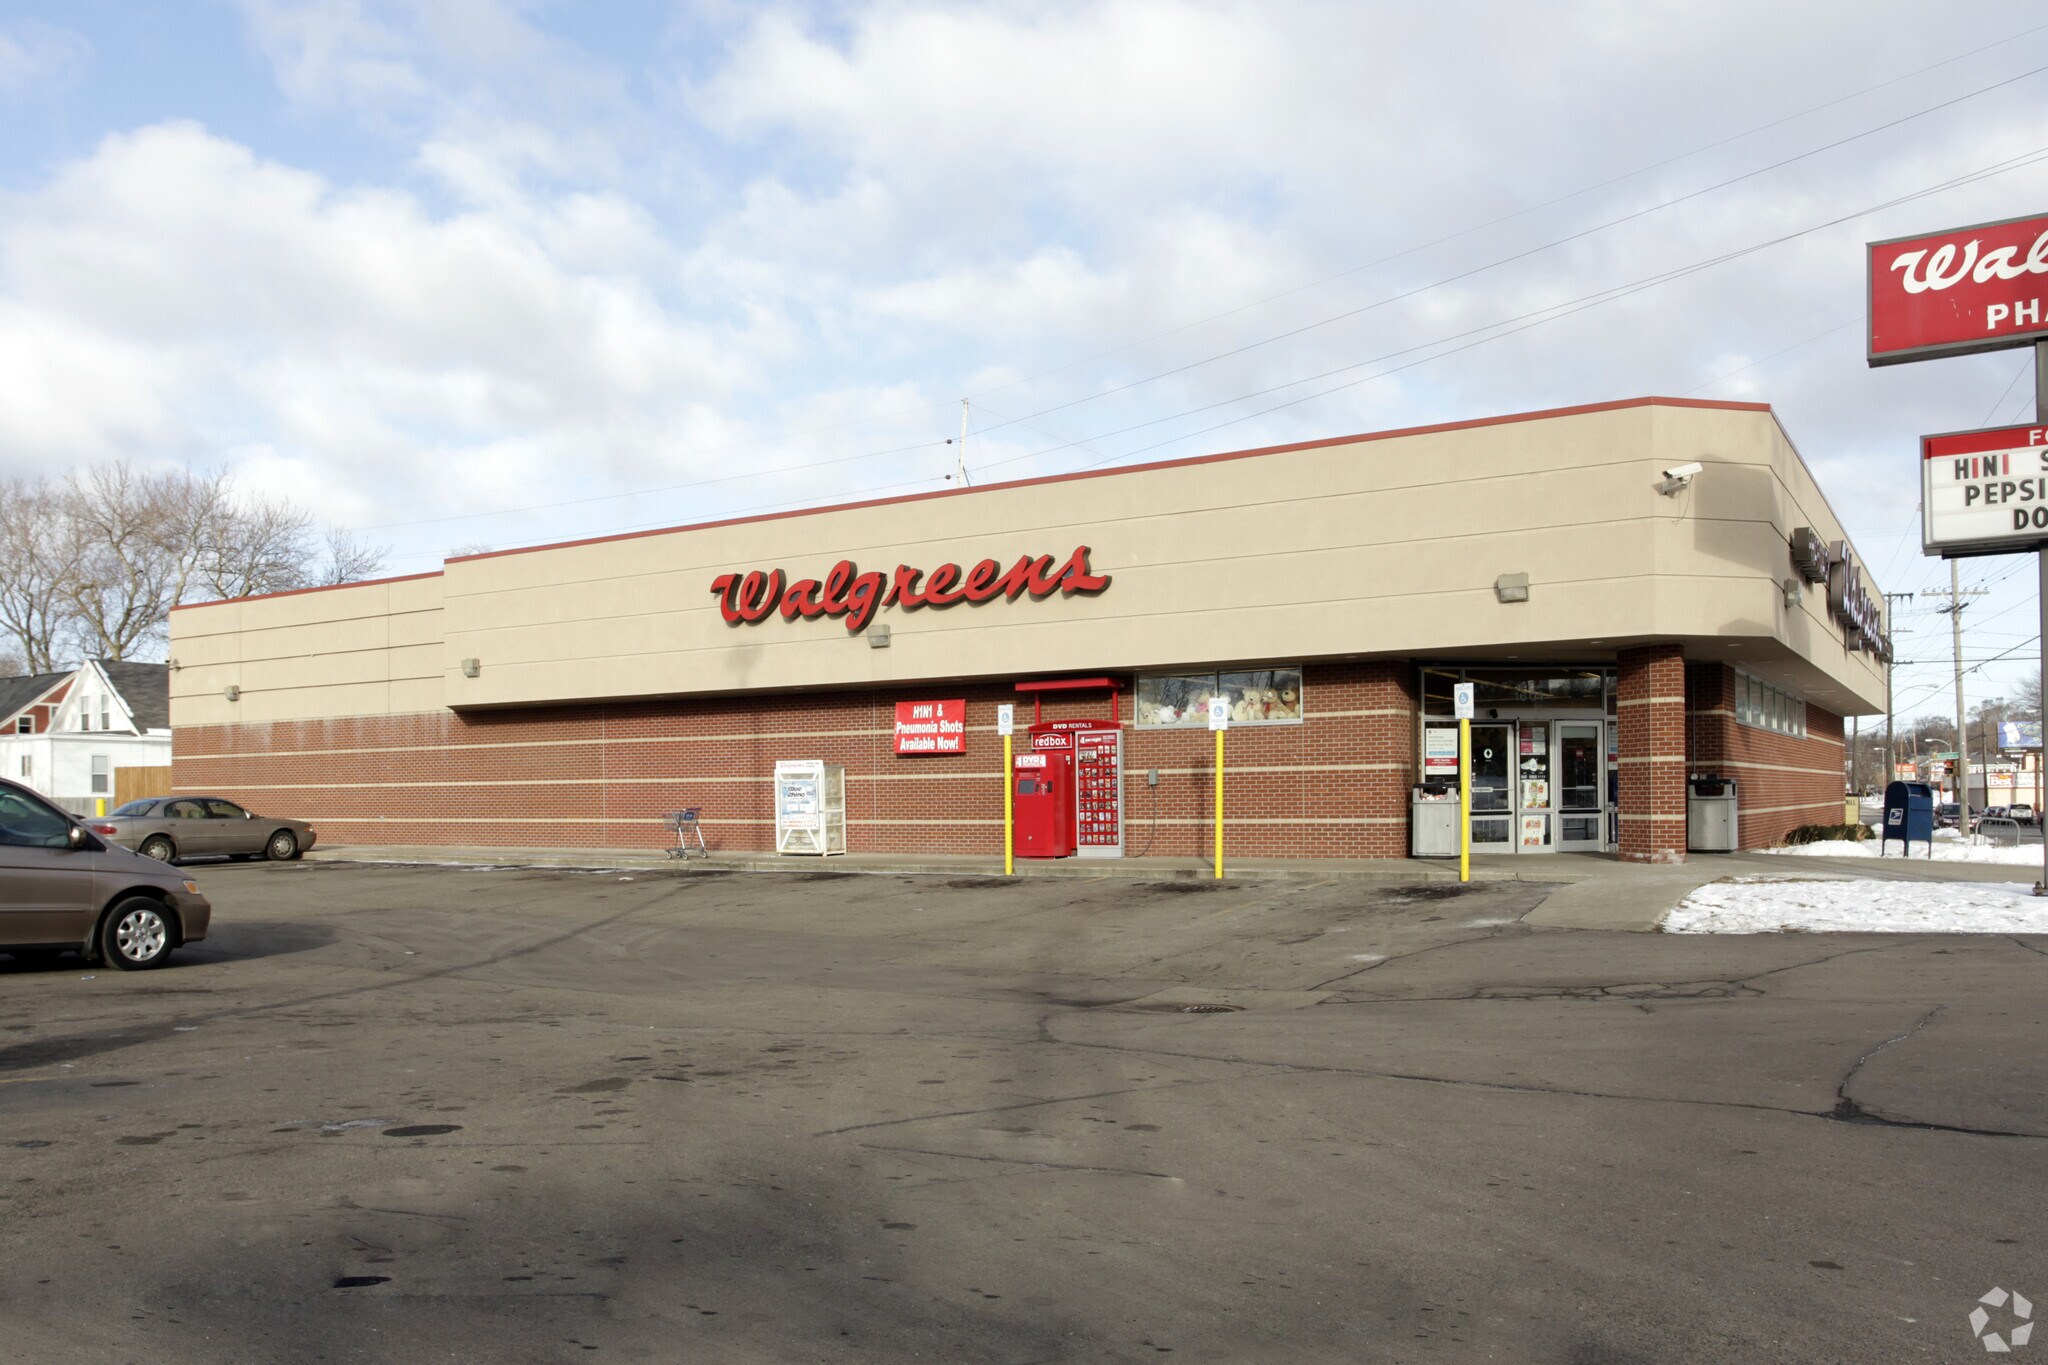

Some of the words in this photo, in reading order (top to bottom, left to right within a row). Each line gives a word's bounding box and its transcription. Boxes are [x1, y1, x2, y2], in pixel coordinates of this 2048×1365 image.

[1987, 298, 2048, 330] PH
[1965, 478, 2046, 506] PEPSI
[710, 545, 1112, 636] Walgreens
[913, 704, 933, 718] H1N1
[937, 703, 944, 717] &
[896, 720, 938, 735] Pneumonia
[939, 719, 964, 733] Shots
[900, 736, 936, 751] Available
[937, 736, 959, 750] Now!
[1035, 736, 1067, 747] redbox
